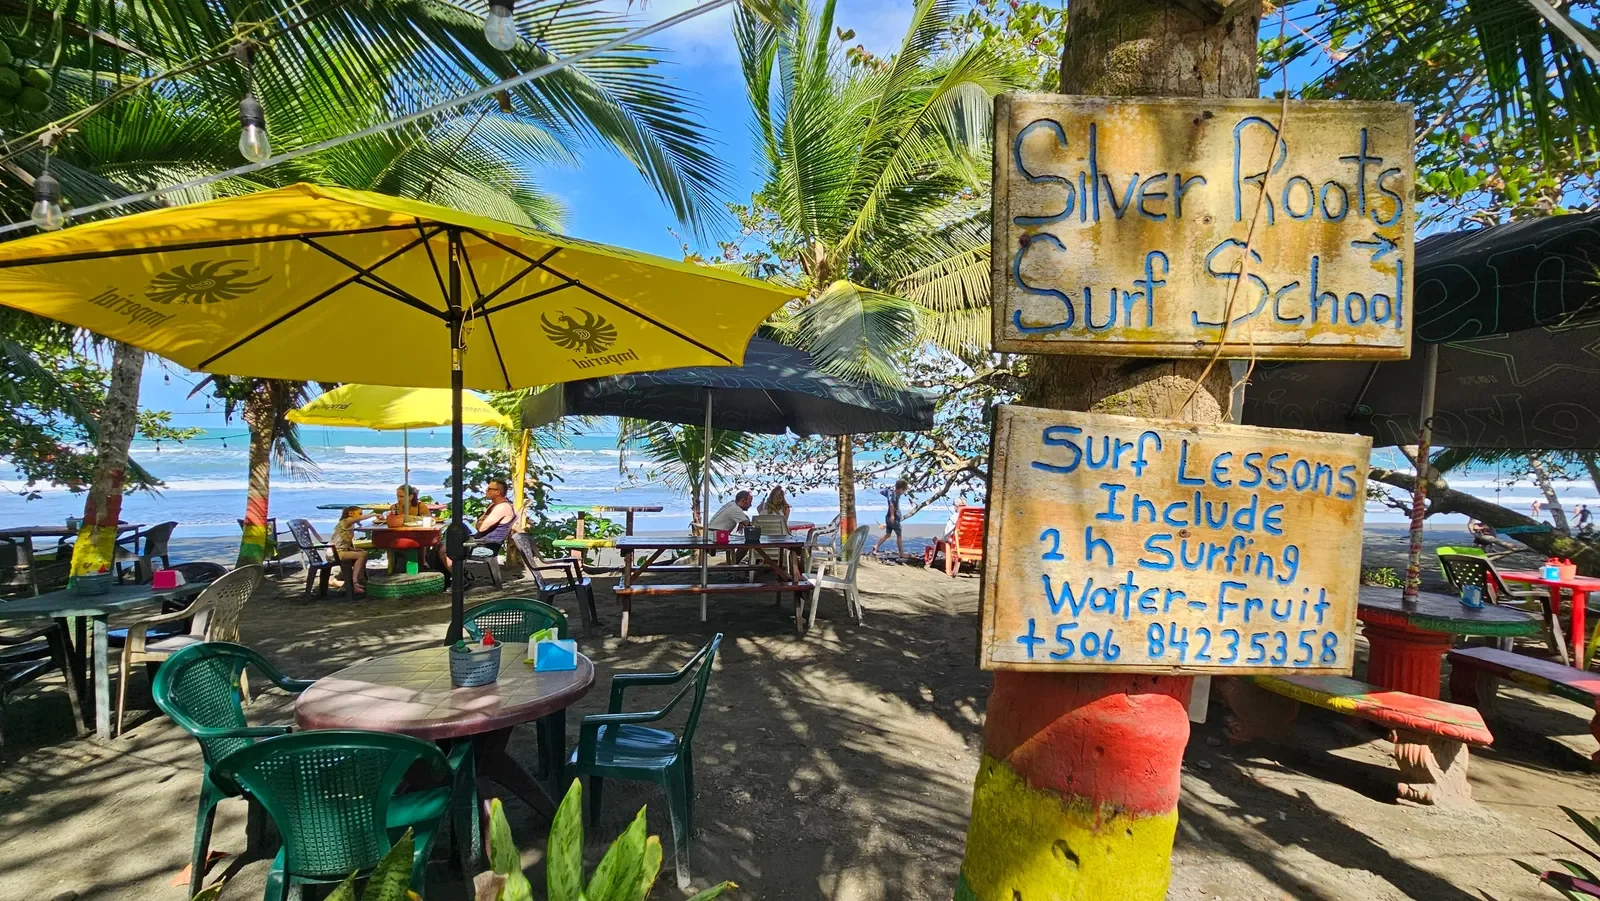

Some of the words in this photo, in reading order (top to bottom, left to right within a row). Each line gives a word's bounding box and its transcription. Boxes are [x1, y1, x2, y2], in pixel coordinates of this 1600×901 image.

[1013, 117, 1207, 226] Silver
[1233, 116, 1402, 227] Roots
[1012, 232, 1170, 334] Surf
[1192, 238, 1403, 329] School
[1031, 425, 1162, 477] Surf
[1177, 439, 1357, 500] Lessons
[1096, 482, 1285, 536] Include
[1039, 528, 1064, 561] 2
[1085, 525, 1114, 567] h
[1137, 533, 1300, 586] Surfing
[1041, 570, 1331, 625] Water-Fruit
[1016, 618, 1122, 663] +506
[1147, 622, 1338, 667] 84235358
